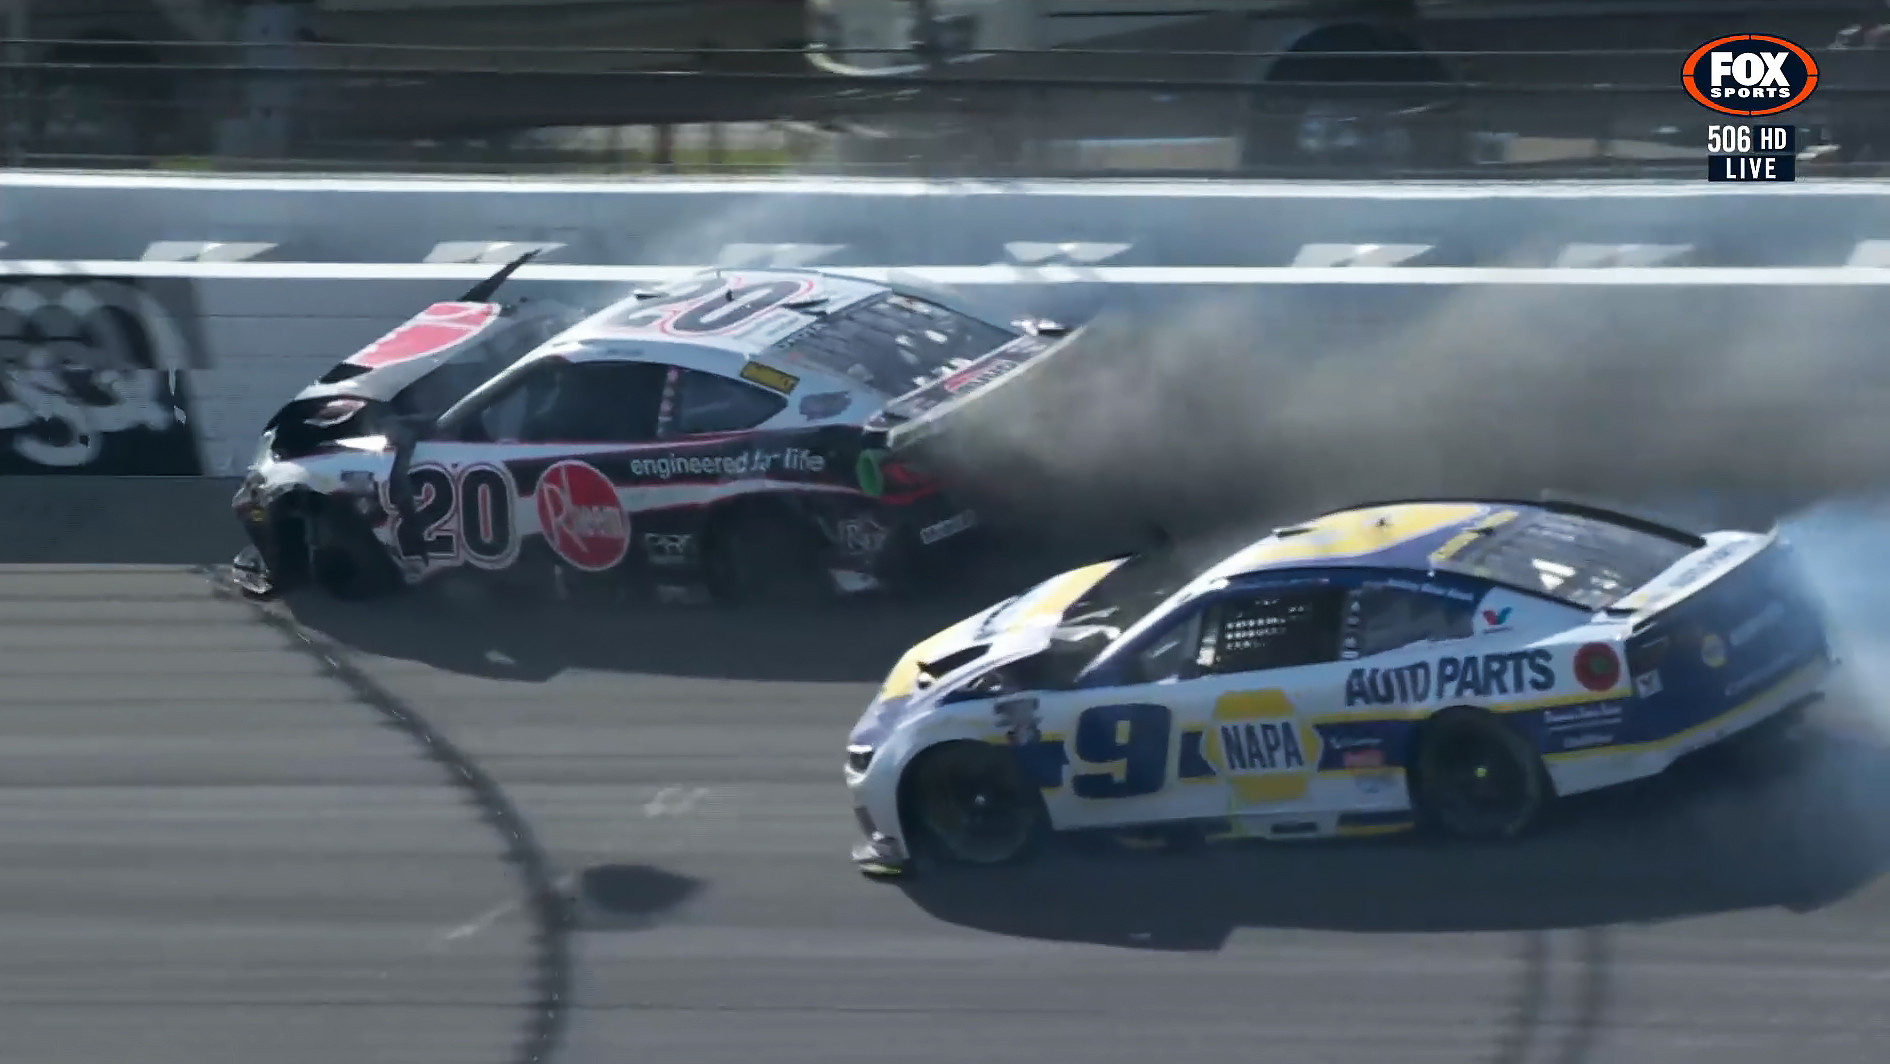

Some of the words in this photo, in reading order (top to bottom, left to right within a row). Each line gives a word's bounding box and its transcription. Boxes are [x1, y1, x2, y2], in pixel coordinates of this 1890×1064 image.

[601, 275, 806, 334] 20
[629, 451, 749, 479] engineered
[784, 447, 826, 472] life
[386, 463, 518, 566] 20
[1345, 660, 1431, 707] AUTO
[1435, 648, 1556, 699] PARTS
[1071, 702, 1172, 799] 9
[1220, 721, 1305, 770] NAPA
